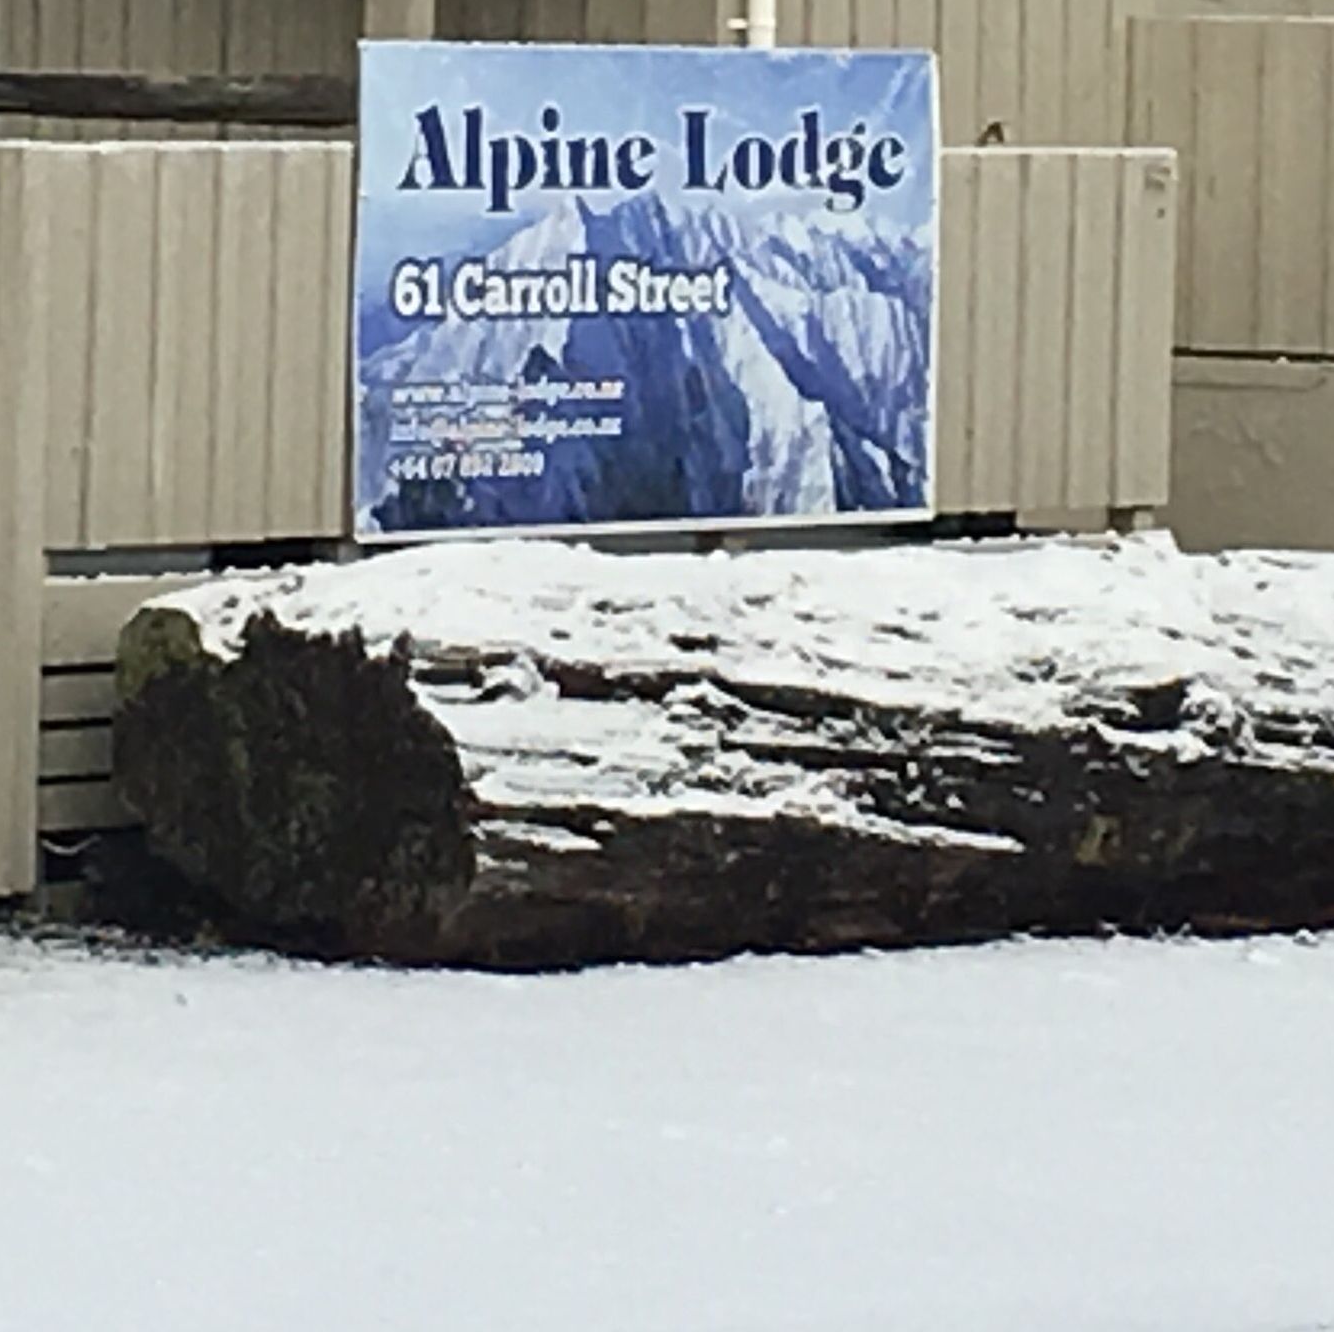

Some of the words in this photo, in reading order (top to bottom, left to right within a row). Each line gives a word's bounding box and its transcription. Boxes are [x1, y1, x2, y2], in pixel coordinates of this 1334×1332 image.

[396, 103, 657, 213] Alpine
[681, 108, 905, 213] Lodge
[393, 263, 443, 317] 61
[453, 258, 599, 317] Carroll
[606, 260, 730, 315] Street
[388, 455, 428, 480] +64
